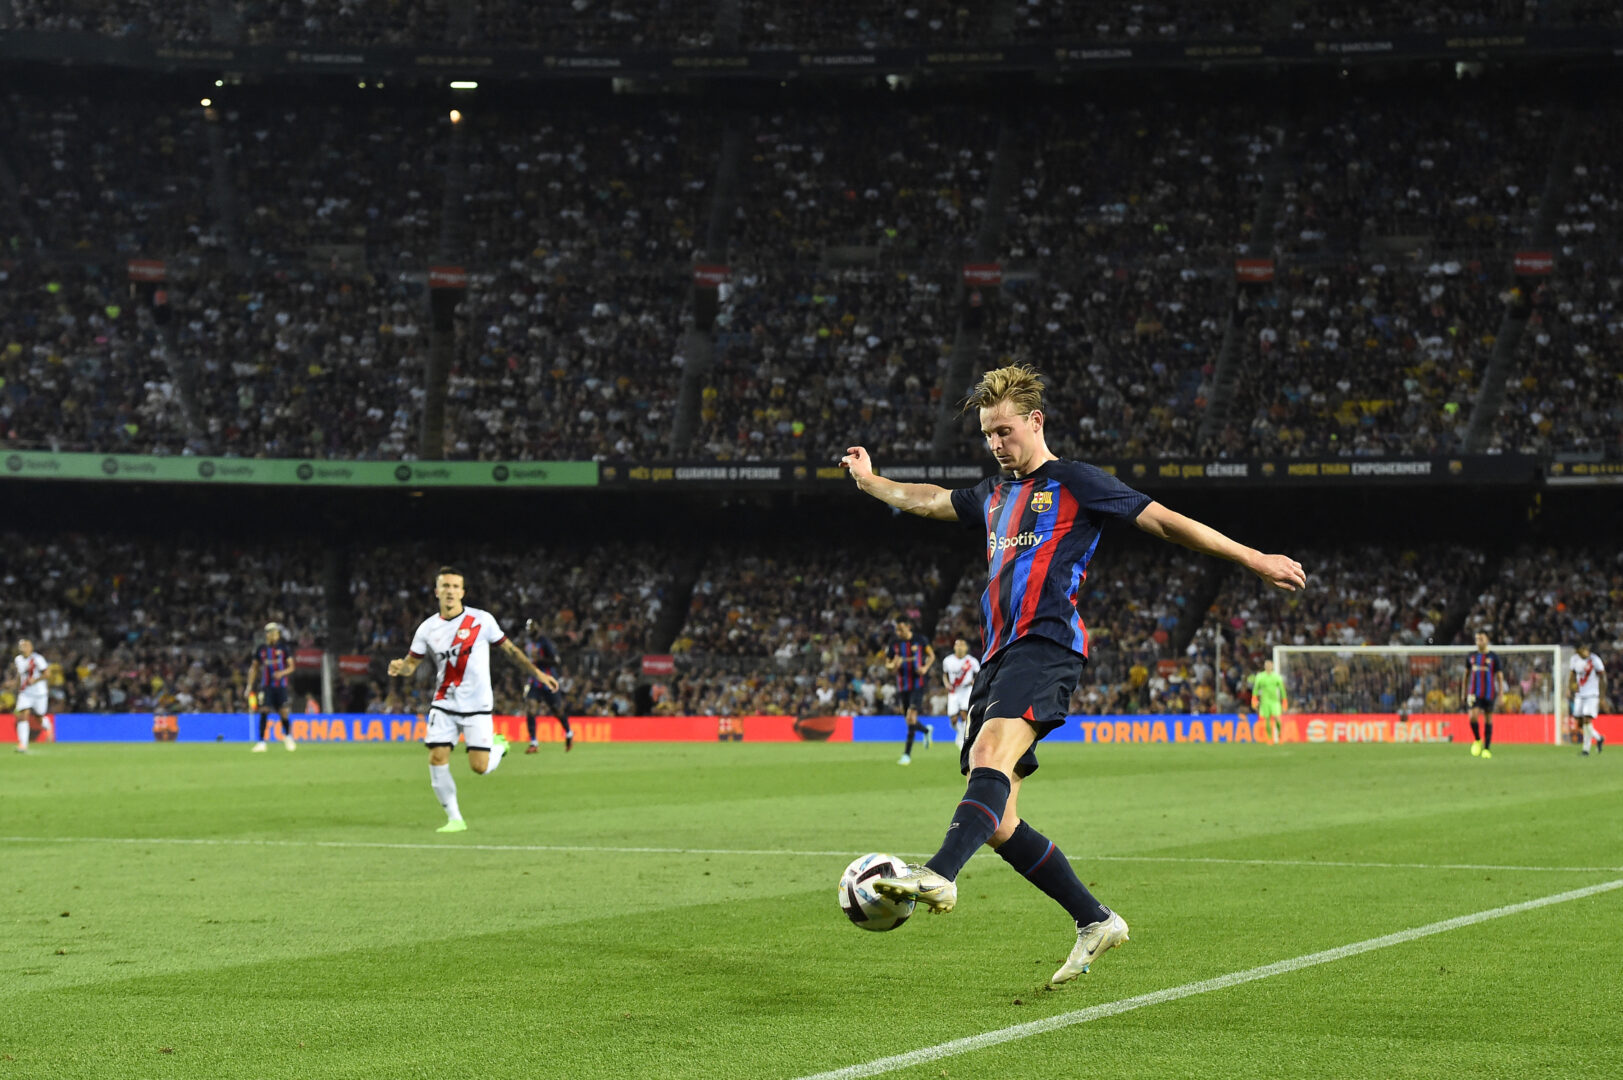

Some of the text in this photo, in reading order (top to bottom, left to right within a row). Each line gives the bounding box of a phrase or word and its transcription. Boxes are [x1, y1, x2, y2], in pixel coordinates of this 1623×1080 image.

[998, 531, 1043, 551] Spotify
[353, 720, 384, 741] LA
[1080, 721, 1168, 742] TORNA
[1174, 721, 1206, 742] LA
